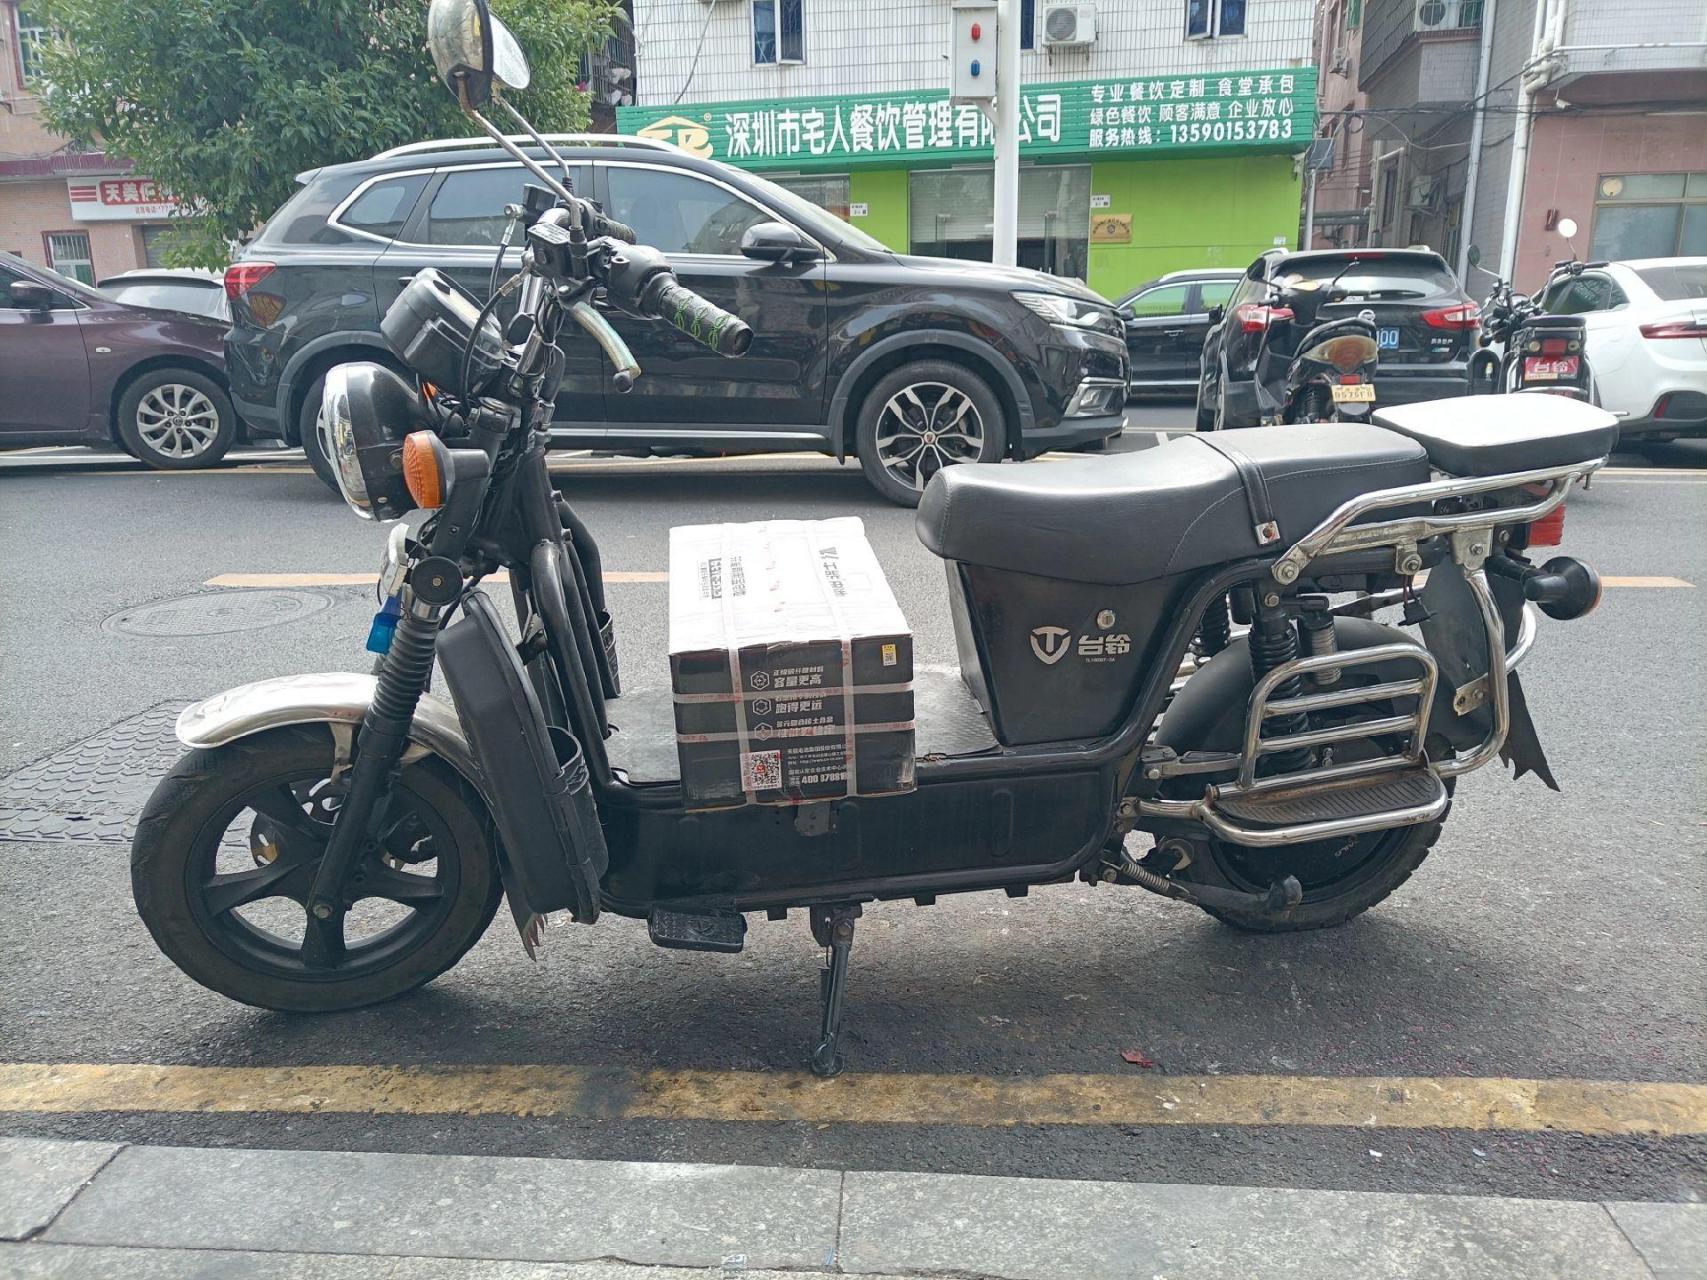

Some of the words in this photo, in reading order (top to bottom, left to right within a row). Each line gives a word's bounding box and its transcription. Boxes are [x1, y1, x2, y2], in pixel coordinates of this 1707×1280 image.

[1091, 79, 1204, 103] 专业餐饮定制
[1218, 75, 1294, 97] 食堂承包
[1089, 104, 1152, 126] 绿色餐饮
[1159, 101, 1221, 123] 顾客满意
[1228, 98, 1294, 119] 企业放心
[1078, 633, 1132, 655] 台铃
[774, 674, 822, 689] 容量更高
